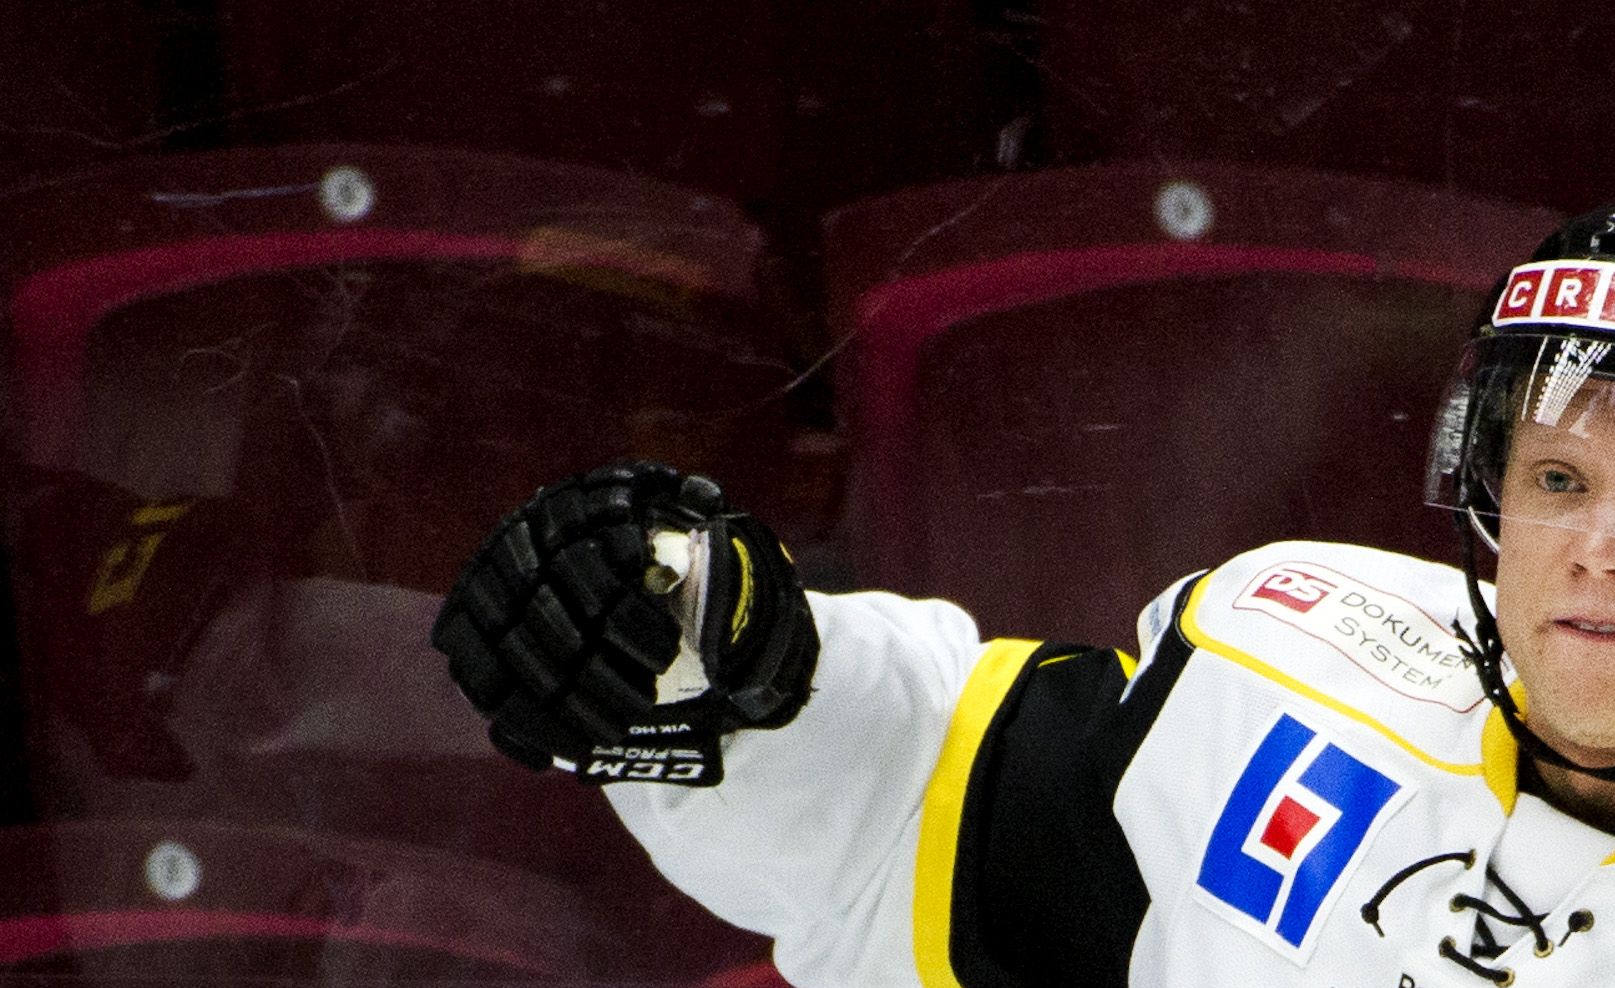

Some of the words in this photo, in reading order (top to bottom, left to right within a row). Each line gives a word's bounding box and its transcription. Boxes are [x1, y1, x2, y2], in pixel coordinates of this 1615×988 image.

[1334, 616, 1443, 690] SYSTEM
[1340, 591, 1476, 670] DOKUMEN
[586, 759, 705, 780] CCM
